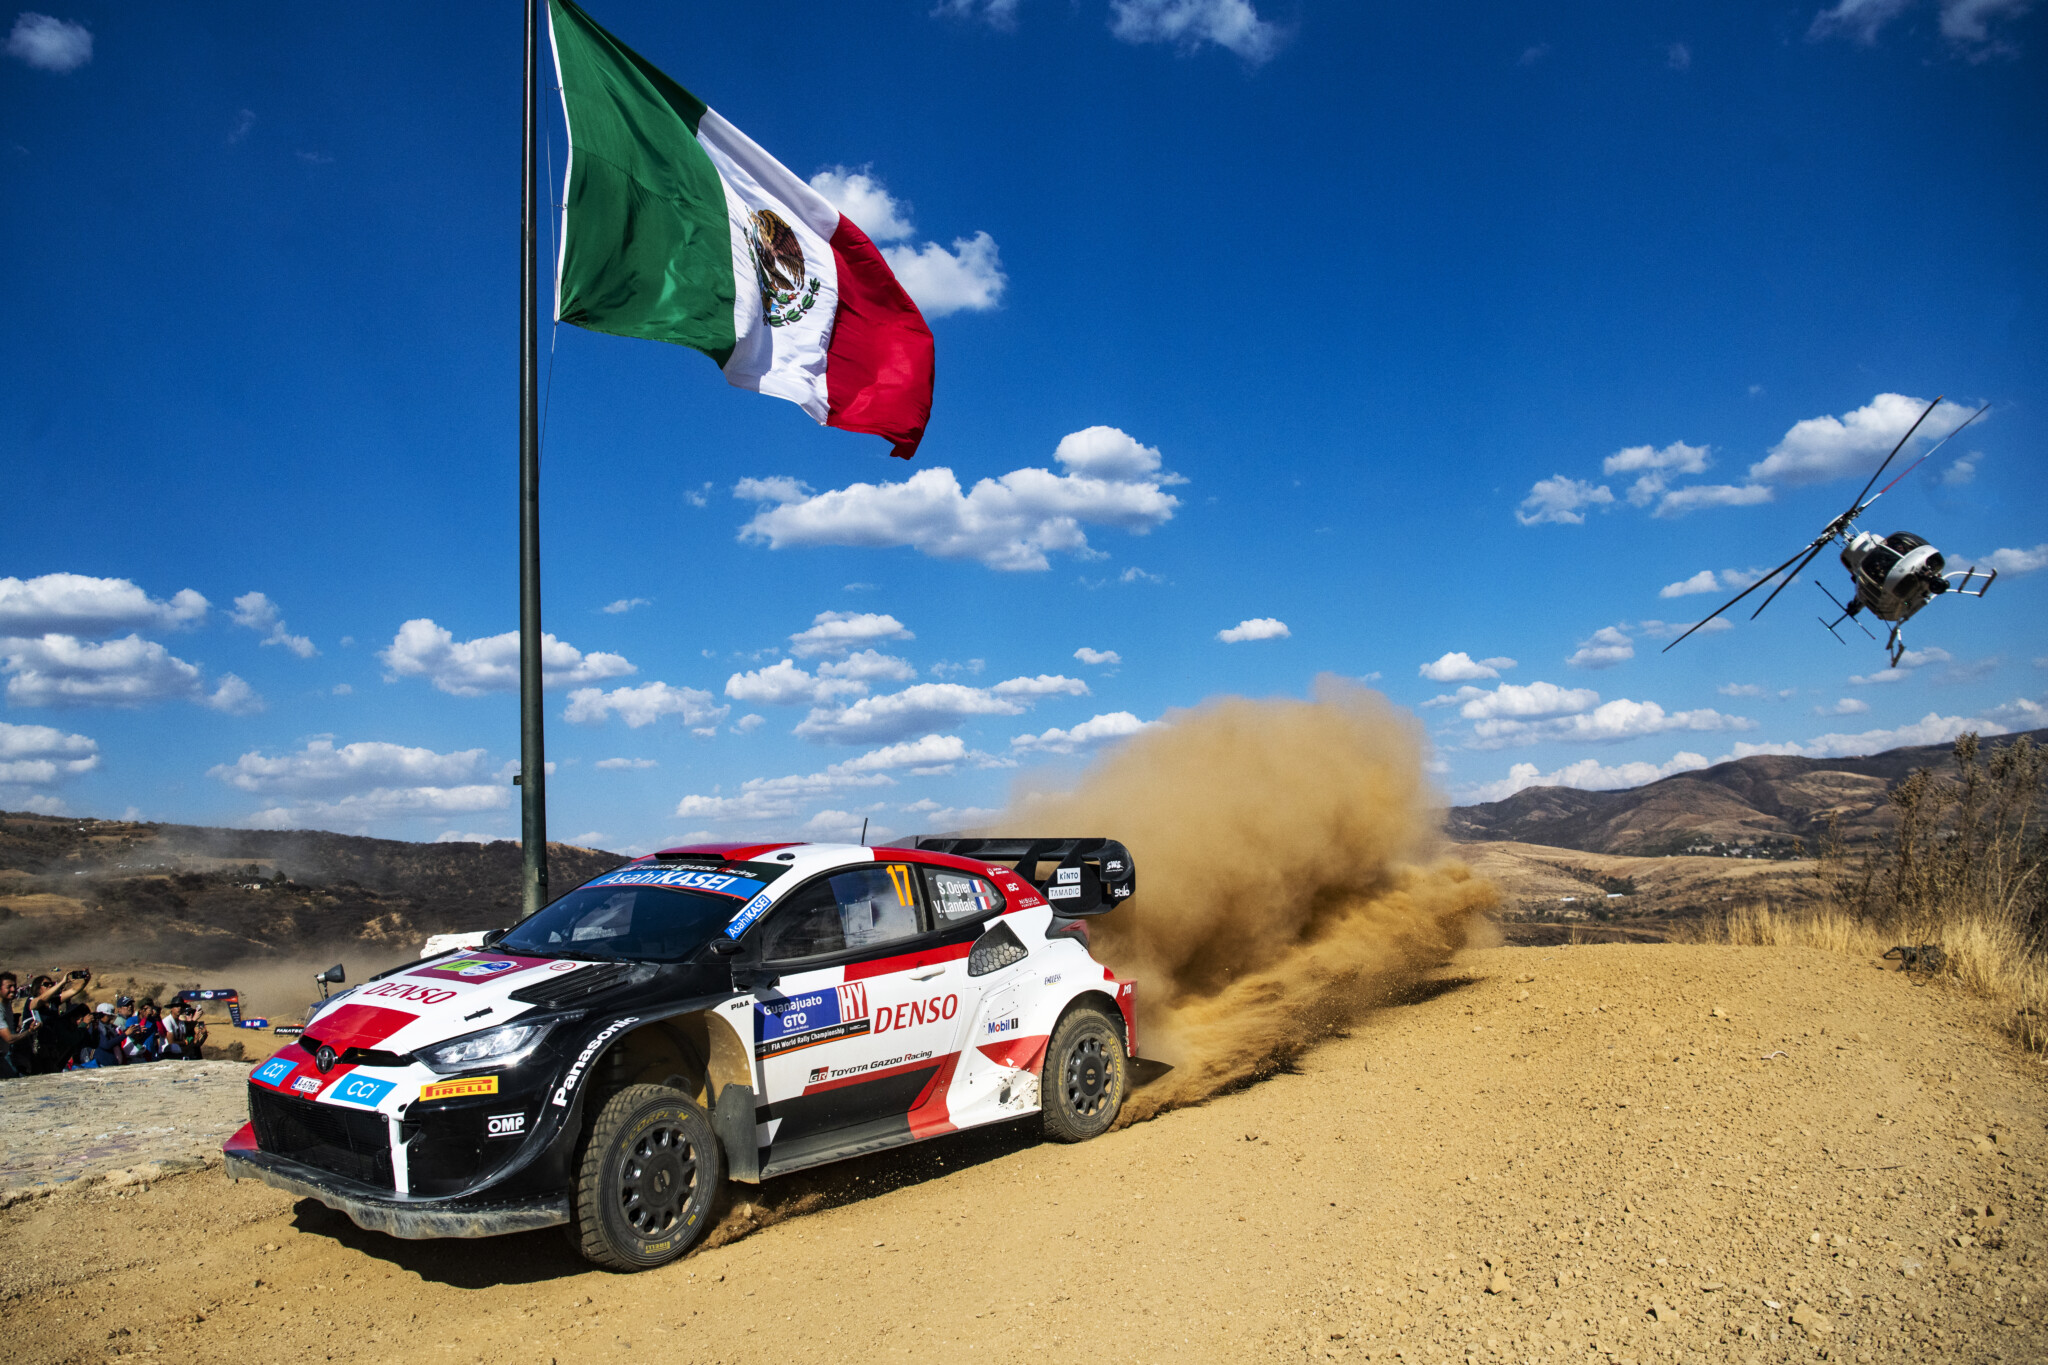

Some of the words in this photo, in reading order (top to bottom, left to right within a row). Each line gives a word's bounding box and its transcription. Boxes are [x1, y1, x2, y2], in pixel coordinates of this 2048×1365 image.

[606, 870, 739, 891] AsahiKASEI
[716, 867, 758, 878] Racing
[886, 864, 914, 907] 17
[937, 879, 971, 897] S.Ogier
[1050, 887, 1080, 897] TAMADIC
[933, 898, 977, 914] V.Landais
[728, 895, 771, 939] AsahiKASEI
[363, 982, 458, 1004] DENSO
[838, 982, 867, 1022] HY
[731, 1000, 750, 1011] PIAA
[763, 995, 823, 1016] Guanajuato
[873, 993, 958, 1034] DENSO
[783, 1012, 807, 1028] GTO
[988, 1019, 1011, 1034] Mobil
[771, 1042, 781, 1051] FIA
[781, 1038, 797, 1049] World
[797, 1035, 810, 1045] Rally
[810, 1027, 845, 1041] Championship
[552, 1016, 640, 1107] Panasonic
[830, 1064, 869, 1078] TOYOTA
[870, 1056, 903, 1070] GAZOO
[903, 1050, 933, 1063] Racing
[425, 1079, 493, 1098] PIRELLI
[488, 1116, 525, 1134] OMP
[621, 1110, 689, 1149] SCORPIN
